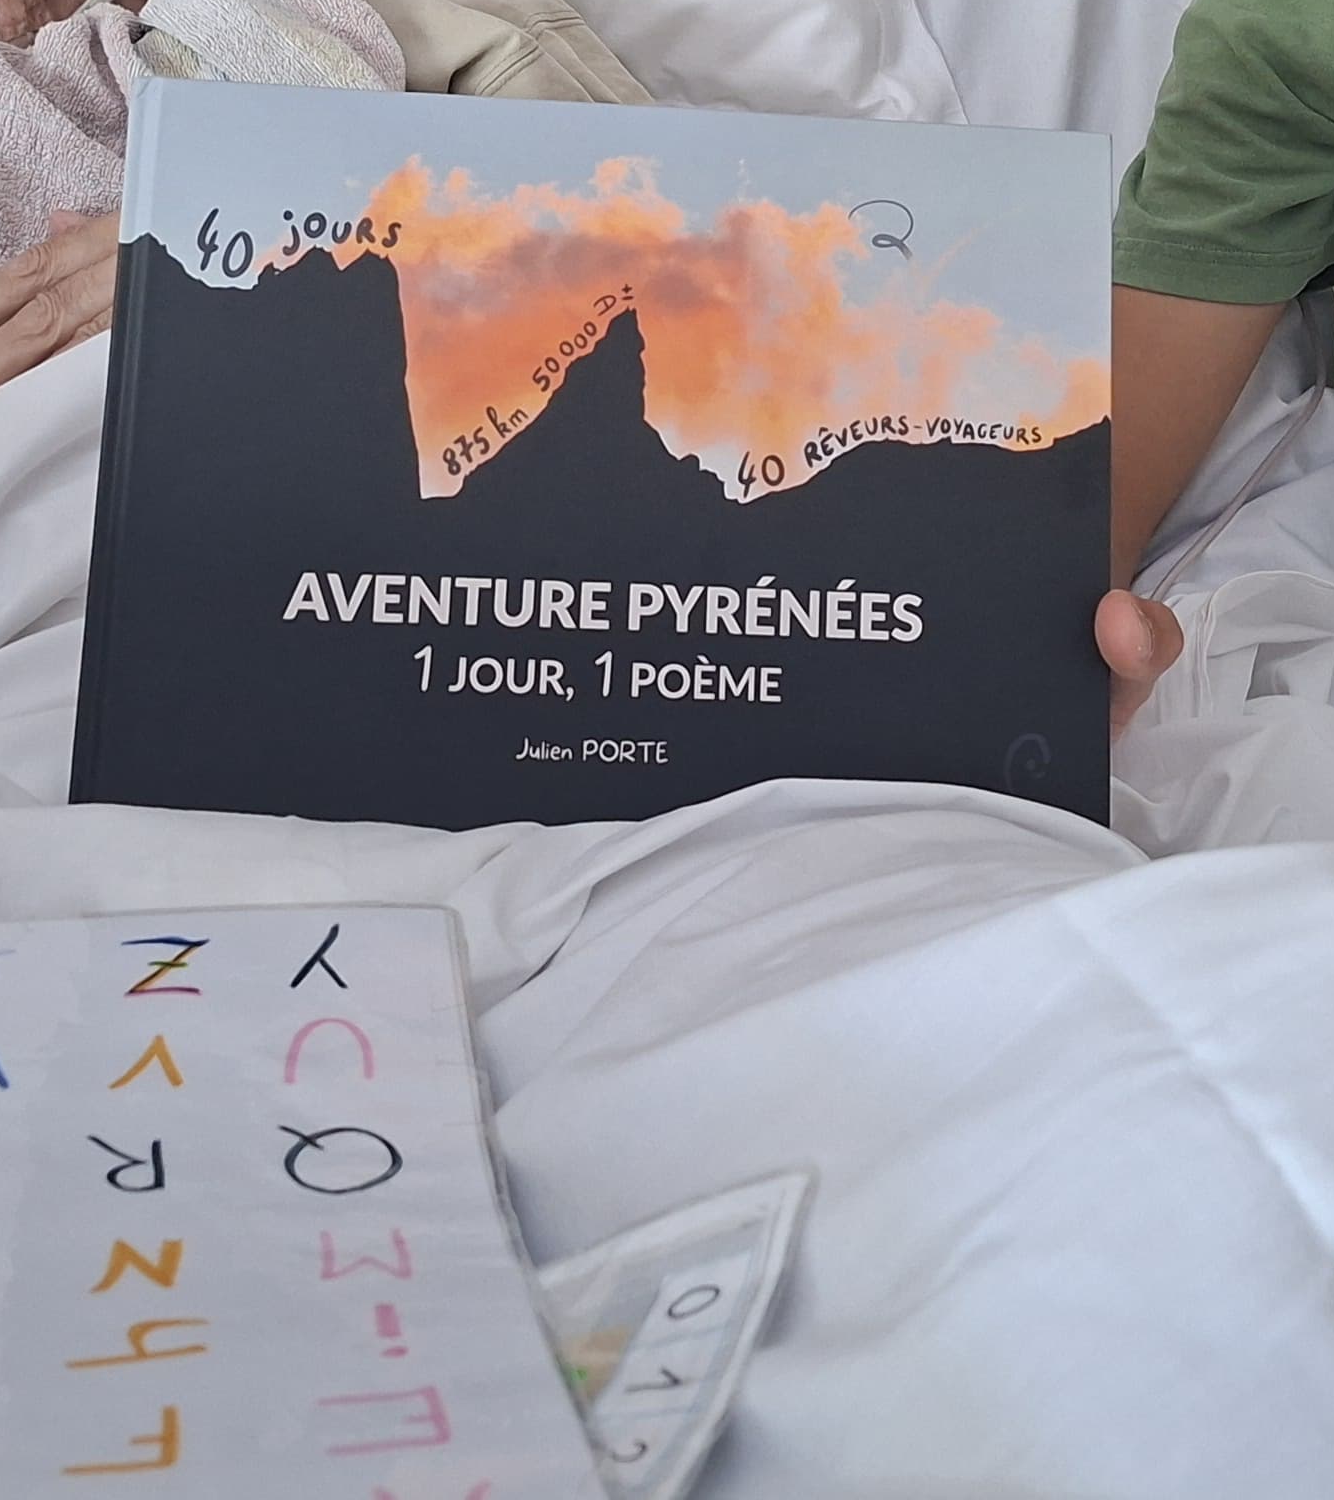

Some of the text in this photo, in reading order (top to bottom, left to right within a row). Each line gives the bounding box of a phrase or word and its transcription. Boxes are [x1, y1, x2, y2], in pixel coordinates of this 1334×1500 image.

[197, 208, 254, 278] 40
[442, 425, 490, 476] 875
[486, 406, 529, 438] km
[738, 414, 1043, 498] 40 RÊVEURS-VOYAGEURS
[282, 571, 925, 643] AVENTURE PYRÉNÉES
[412, 645, 784, 703] 1 JOUR, 1 POÈME
[515, 737, 669, 765] Julien PORTE
[120, 923, 348, 998] Y Z
[108, 1034, 185, 1090] V
[284, 1017, 375, 1085] U
[85, 1134, 166, 1195] R
[276, 1124, 404, 1197] Q
[90, 1238, 185, 1294] N
[320, 1230, 412, 1280] M
[64, 1318, 209, 1370] J
[624, 1366, 684, 1394] 1
[62, 1405, 182, 1477] F
[317, 1385, 452, 1456] E
